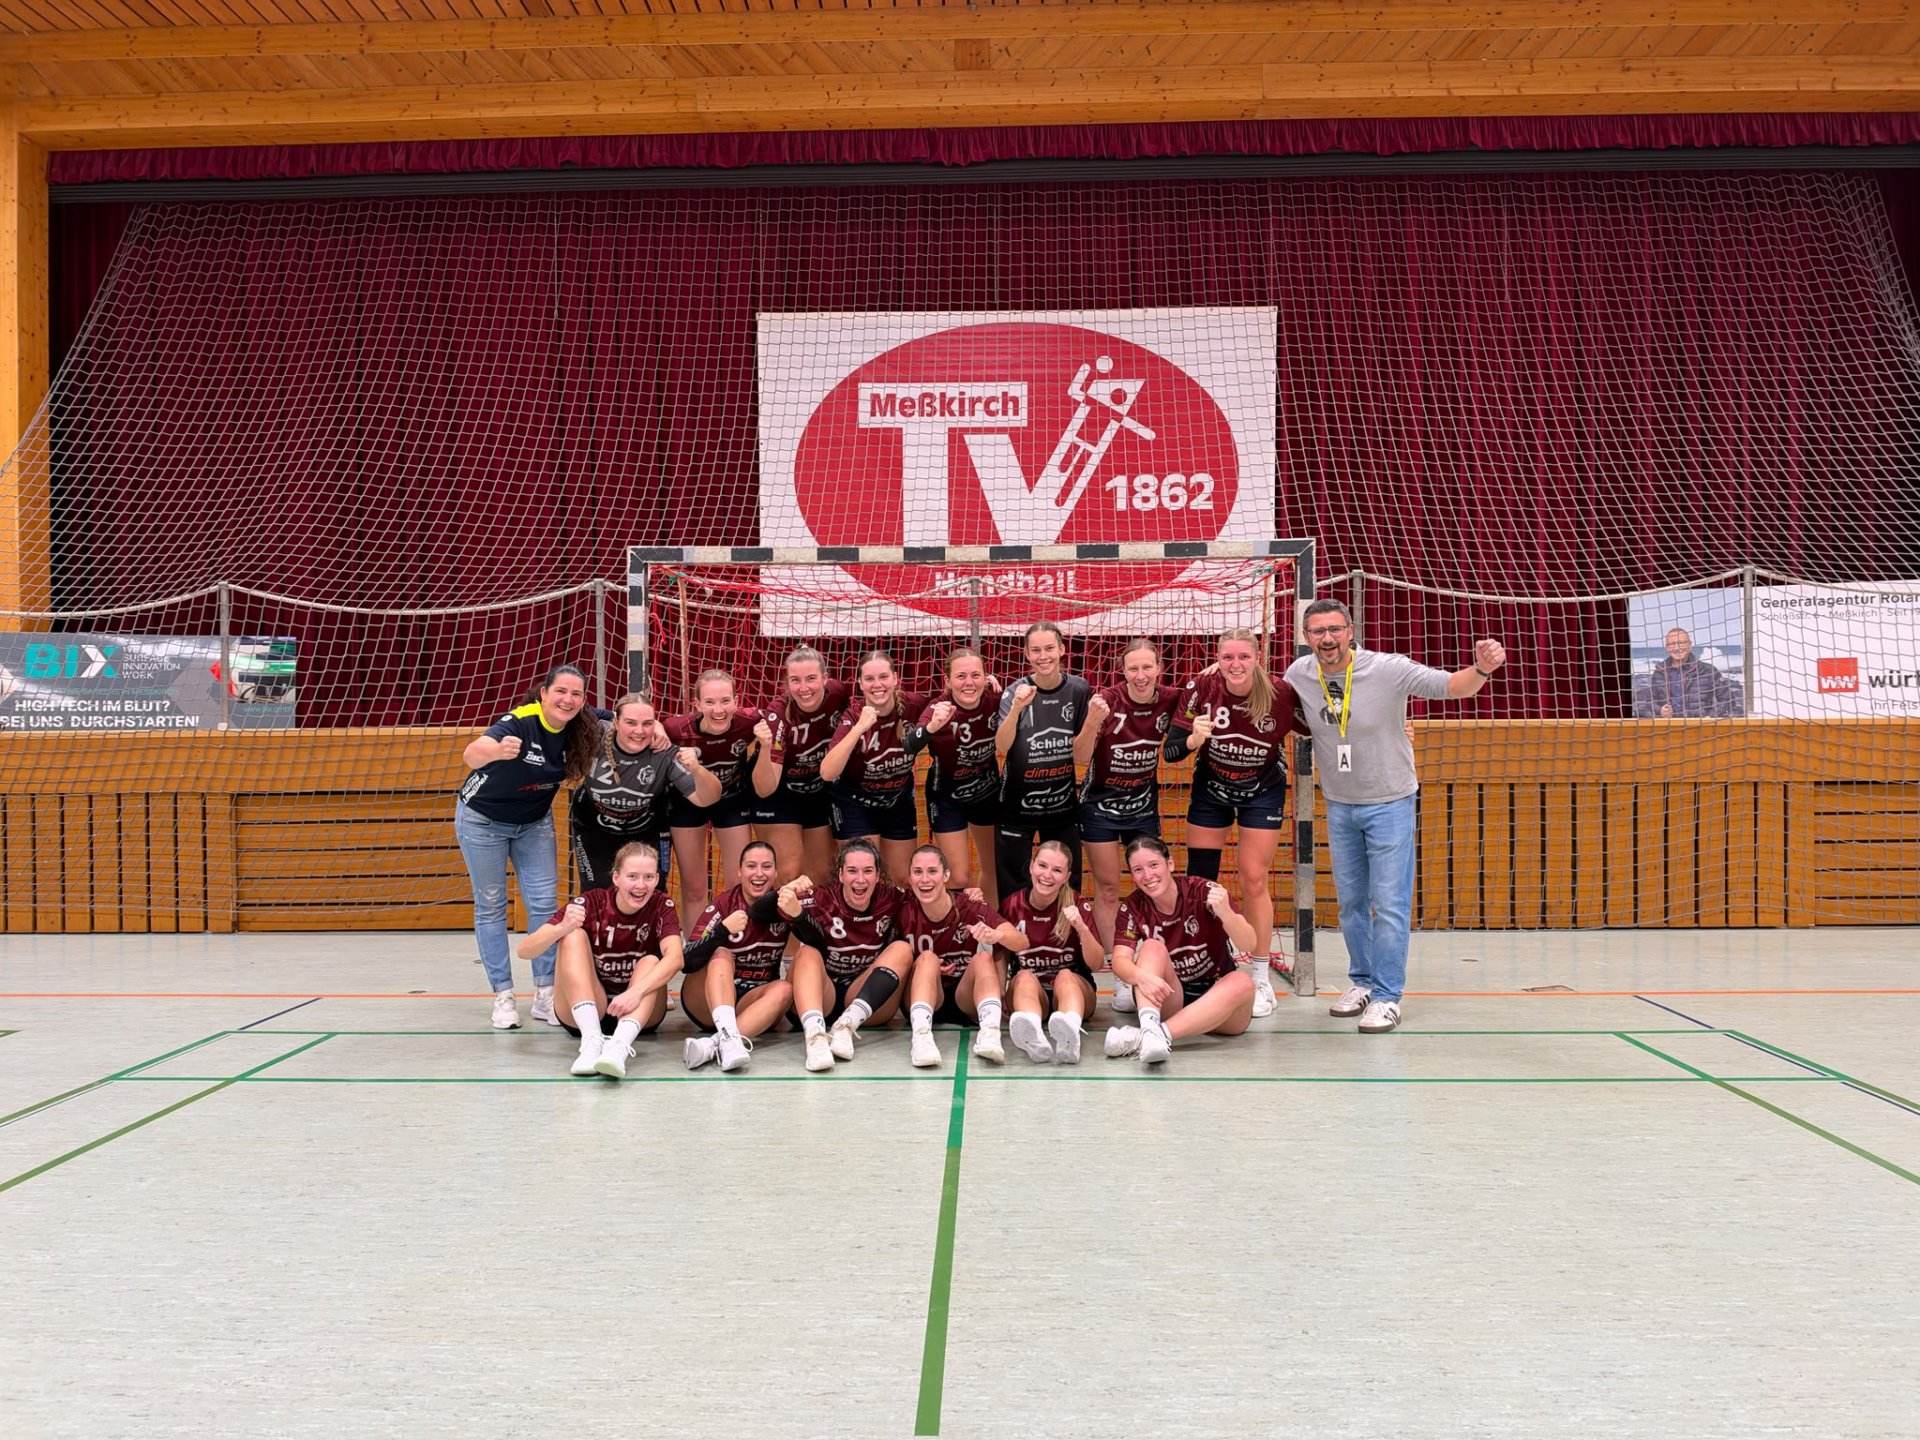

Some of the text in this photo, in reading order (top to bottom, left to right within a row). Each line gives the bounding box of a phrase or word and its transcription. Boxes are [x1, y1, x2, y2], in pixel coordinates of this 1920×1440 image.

[869, 391, 1020, 418] Meßkirch
[859, 382, 1125, 545] TV
[1105, 473, 1215, 511] 1862
[935, 570, 1076, 596] Handball
[1761, 594, 1876, 609] Generalagentur
[1829, 609, 1878, 619] Meßkirch
[1887, 608, 1907, 617] Seit
[122, 662, 180, 671] INNOVATION
[122, 671, 154, 679] WORK
[15, 700, 170, 712] HIGH TECH IM BLUT?
[1232, 704, 1250, 712] Kemp
[1870, 700, 1887, 710] Ihr
[29, 715, 63, 727] UNS
[71, 715, 199, 728] DURCHSTARTEN!
[1113, 712, 1128, 735] 7
[1203, 702, 1230, 729] 18
[791, 722, 811, 745] 17
[950, 721, 972, 743] 13
[861, 731, 881, 754] 14
[1209, 738, 1269, 757] Schiele
[866, 754, 915, 773] Schiele
[1113, 748, 1158, 761] Schiel
[1339, 752, 1351, 769] A
[589, 757, 615, 785] 12
[1028, 794, 1065, 805] JAEGER
[830, 916, 847, 944] 8
[905, 933, 934, 954] 10
[595, 958, 637, 972] Schiel
[829, 950, 879, 964] Schie
[1018, 953, 1074, 967] Schiele
[1170, 949, 1208, 969] hiele
